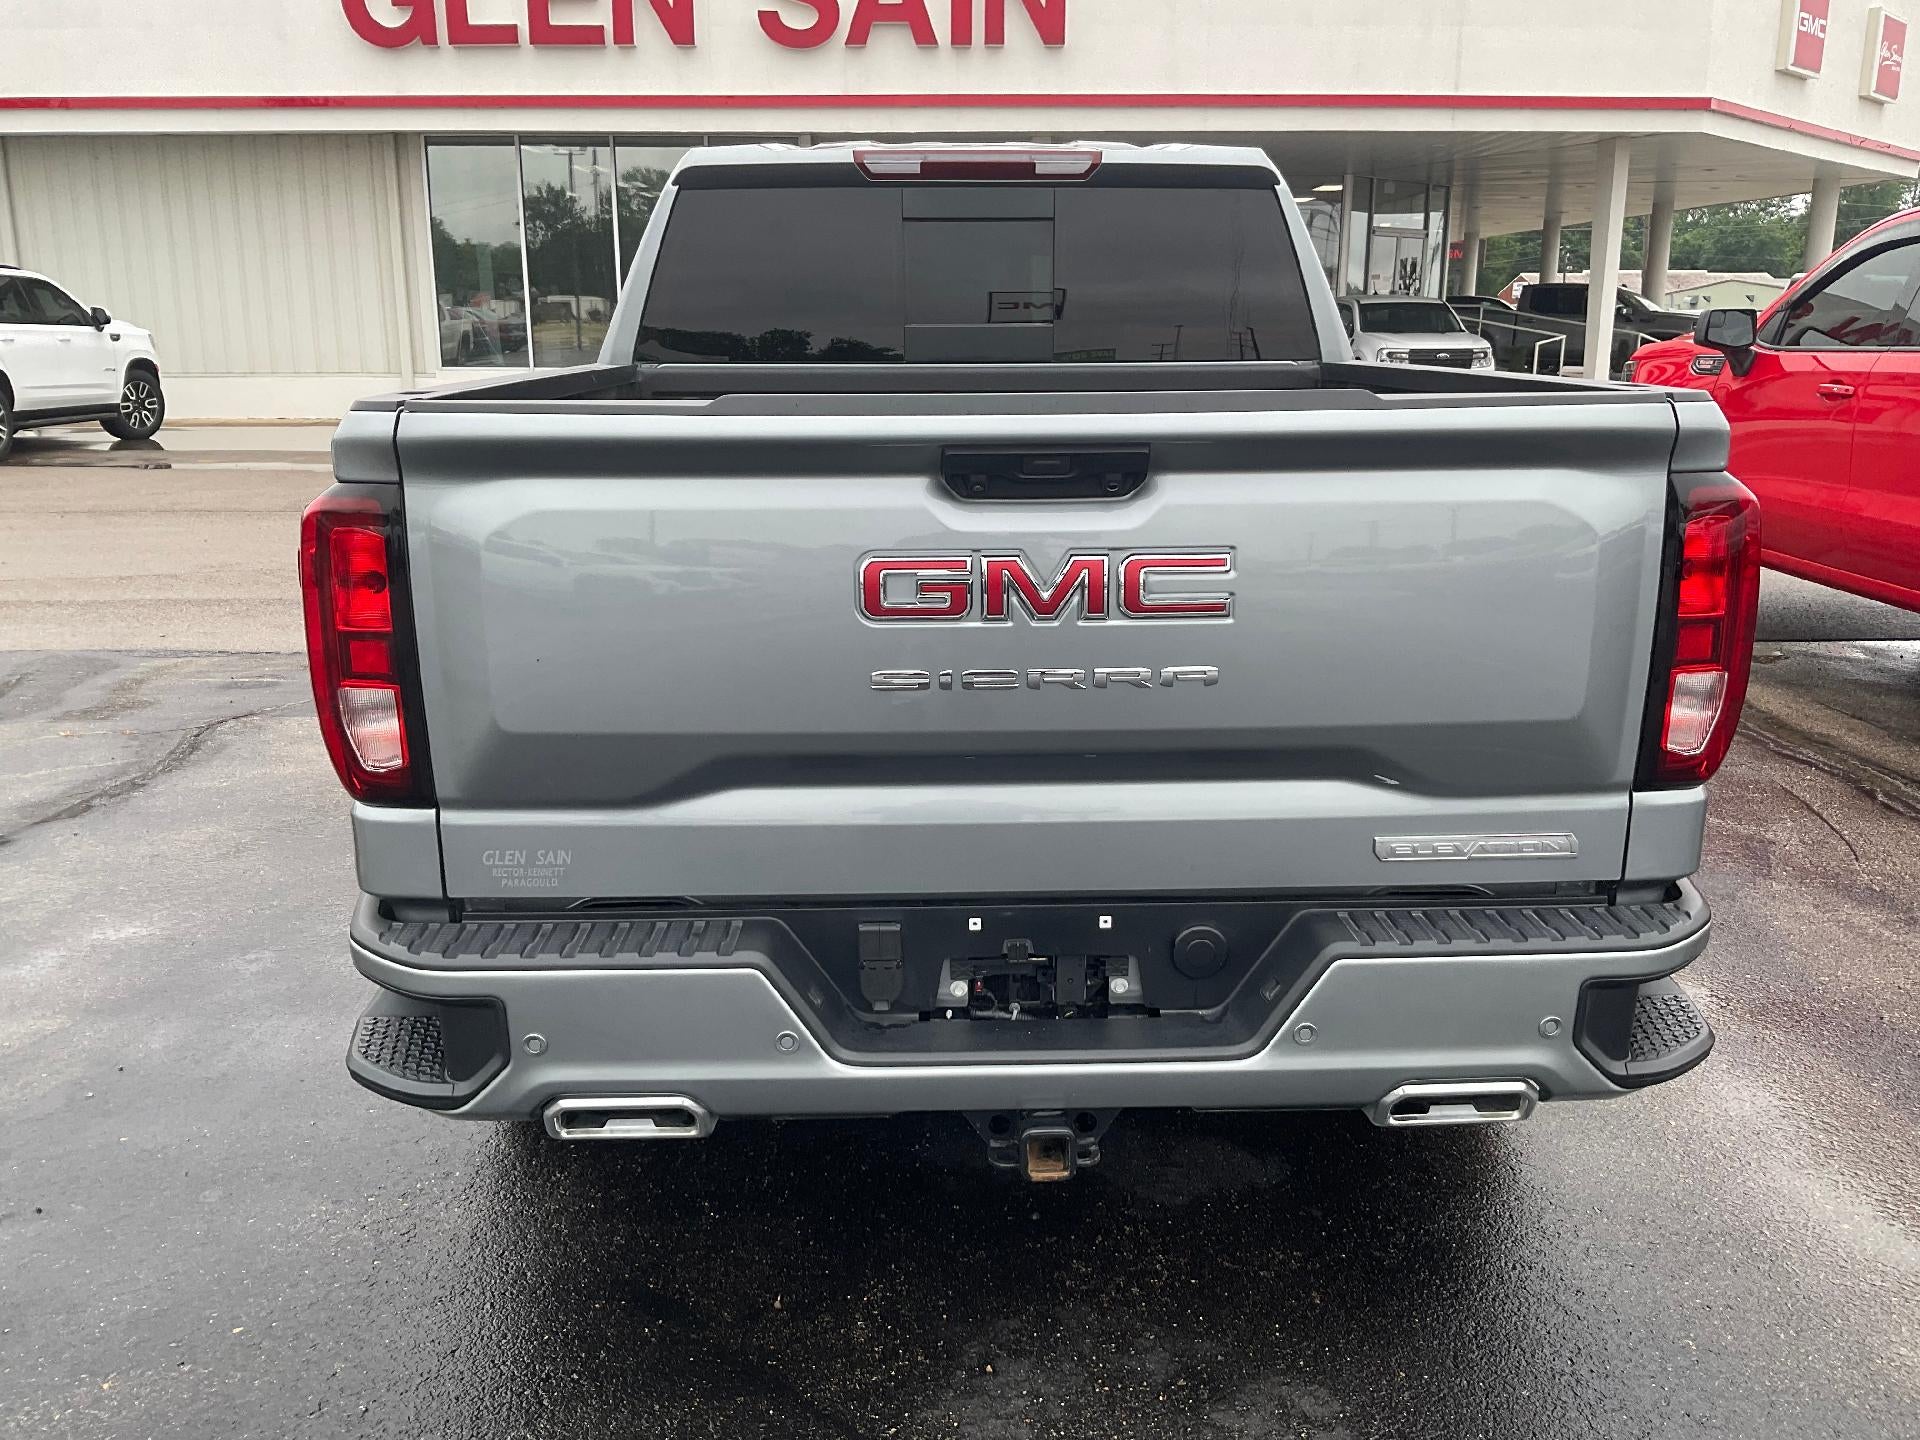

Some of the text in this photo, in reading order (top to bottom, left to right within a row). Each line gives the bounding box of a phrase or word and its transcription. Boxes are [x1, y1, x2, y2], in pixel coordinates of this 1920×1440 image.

[1798, 11, 1827, 38] GMC
[857, 548, 1236, 625] GMC
[870, 665, 1219, 691] SIERRA
[482, 849, 572, 865] GLEN SAIN
[1390, 840, 1565, 854] ELEVATION
[501, 878, 558, 888] PARAGOULD
